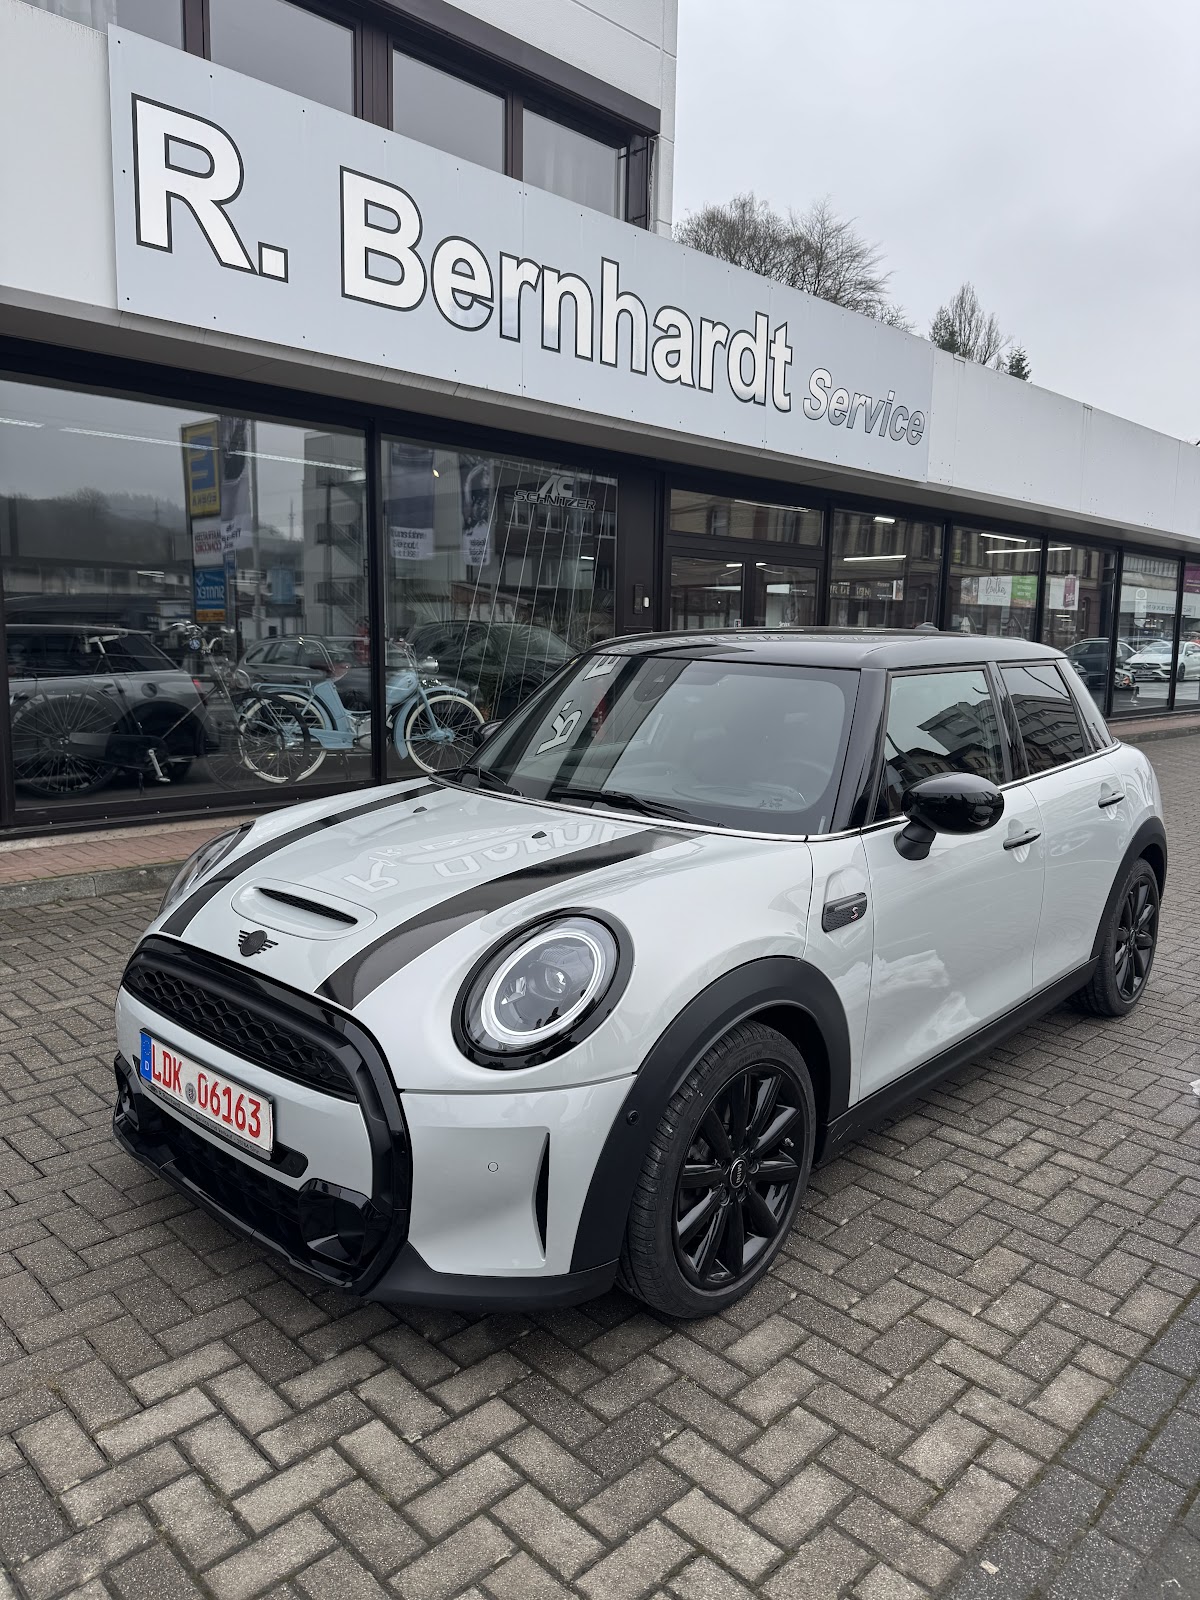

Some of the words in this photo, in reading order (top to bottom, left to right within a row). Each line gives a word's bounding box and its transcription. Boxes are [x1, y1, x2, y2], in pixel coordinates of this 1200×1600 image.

[131, 93, 289, 283] R.
[339, 164, 793, 413] Bernhardt
[803, 367, 926, 446] Service
[539, 474, 575, 497] AC
[514, 489, 596, 511] SCHNITZER
[144, 1060, 150, 1071] D
[152, 1044, 183, 1095] LDK
[197, 1072, 261, 1139] 06163
